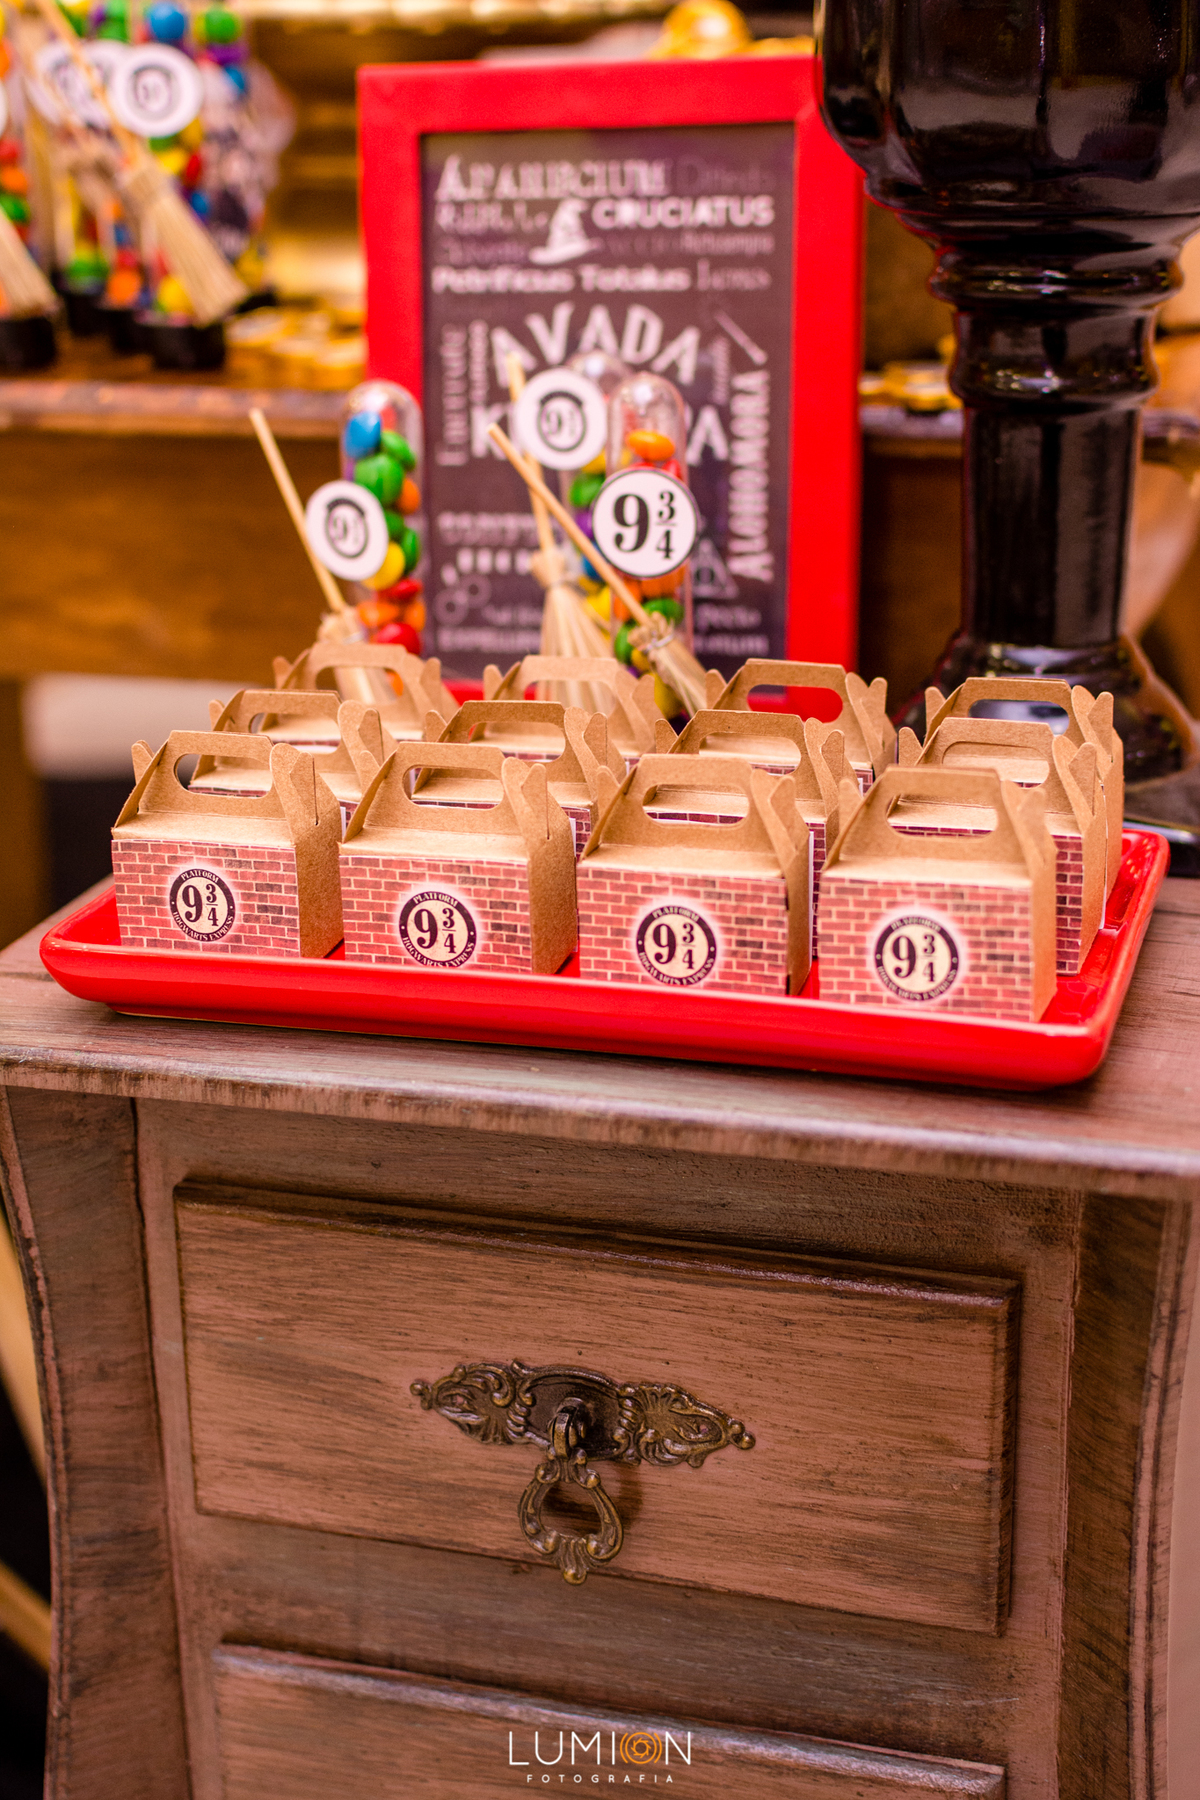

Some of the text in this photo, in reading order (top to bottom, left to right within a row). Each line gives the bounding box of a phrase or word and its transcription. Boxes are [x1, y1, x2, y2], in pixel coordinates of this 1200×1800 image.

[591, 195, 775, 231] CRUCIATUS
[491, 301, 700, 389] AVADA
[180, 869, 220, 883] PLATFORM
[413, 892, 458, 907] PLATFORM
[172, 911, 233, 941] HOGWARTS EXPRESS
